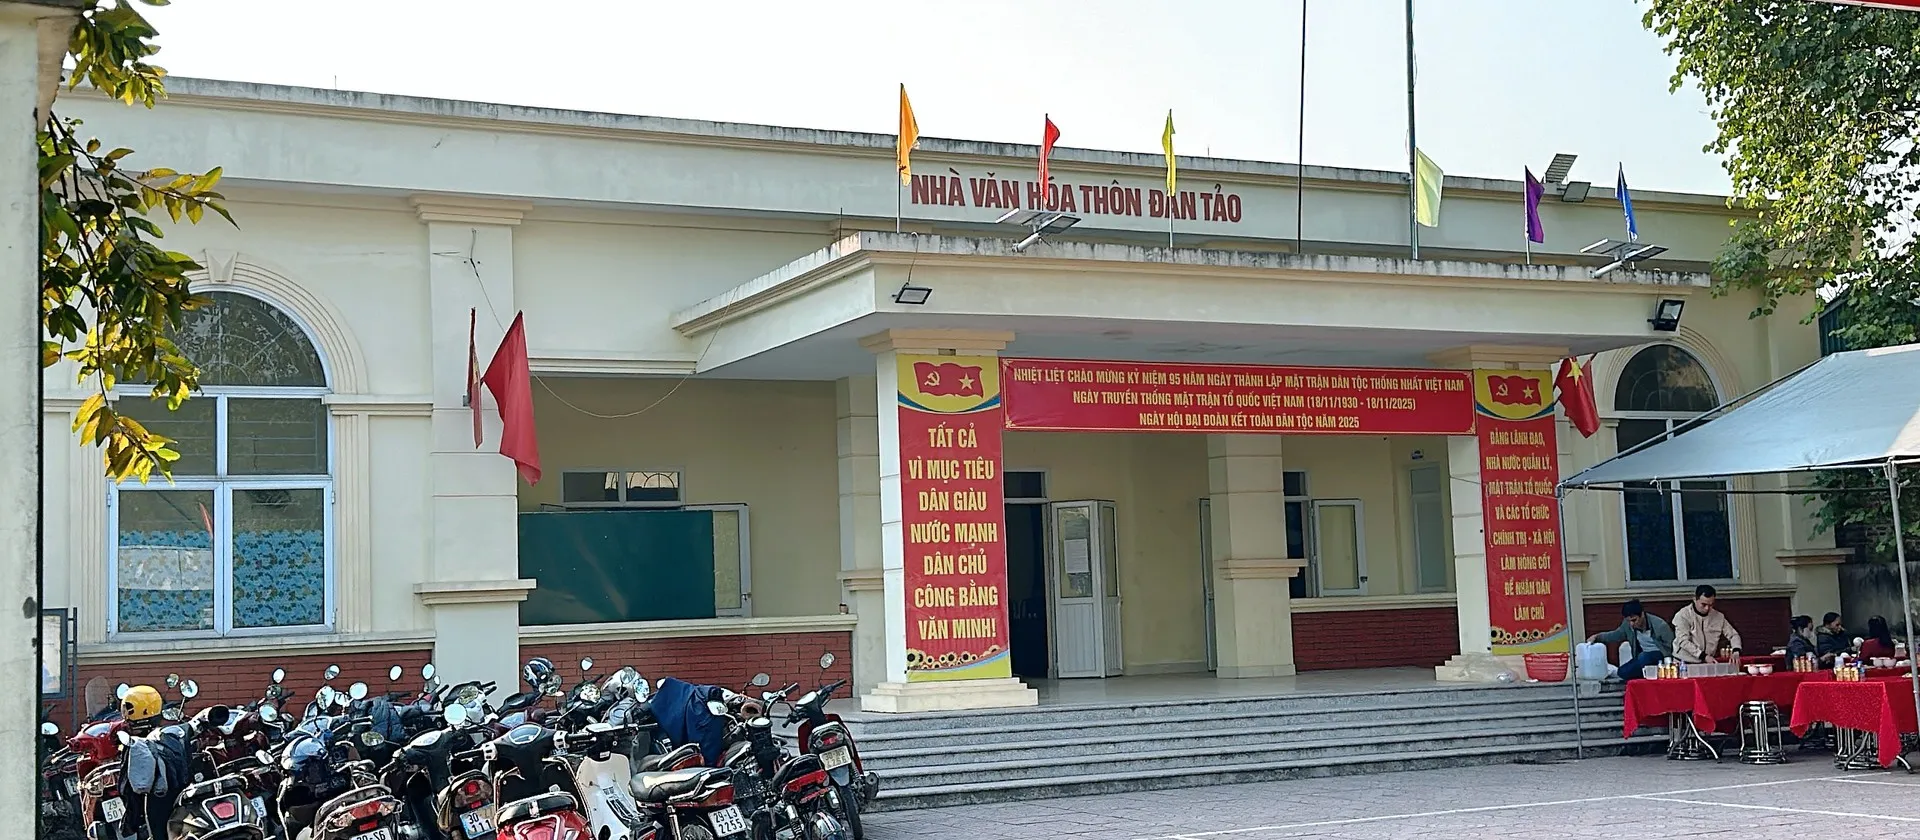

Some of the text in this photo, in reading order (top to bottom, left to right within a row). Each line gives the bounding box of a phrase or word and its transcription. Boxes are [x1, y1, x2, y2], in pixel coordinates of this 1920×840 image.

[911, 167, 965, 206] NHÀ
[969, 172, 1019, 209] VĂN
[1027, 176, 1077, 212] HÓA
[1079, 179, 1142, 217] THÔN
[1200, 183, 1242, 223] TẢO
[1014, 366, 1464, 393] NHIỆT LIỆT CHÀO MỪNG KỶ NIỆM 95 NĂM NGÀY THÀNH LẬP MẶT TRẬN DÂN TỘC THỐNG NHẤT VIỆT NAM
[1073, 389, 1099, 404] NGÀY
[1140, 388, 1171, 405] THỐNG
[1174, 391, 1194, 408] MẶT
[1196, 391, 1220, 408] TRẬN
[1222, 389, 1234, 406] TỔ
[1236, 391, 1260, 408] QUỐC
[1262, 392, 1281, 409] VIỆT
[1283, 395, 1304, 408] NAM
[1307, 396, 1358, 410] (18/11/1930
[1366, 397, 1416, 410] 18/11/2025)
[1139, 410, 1360, 430] NGÀY HỘI ĐẠI ĐOÀN KẾT TOÀN DÂN TỘC NĂM 2025
[928, 421, 977, 448] TẤT CẢ
[1490, 427, 1510, 445] ĐẢNG
[1510, 429, 1529, 445] LÃNH
[908, 456, 995, 484] VÌ MỤC TIÊU
[1486, 454, 1501, 470] NHÀ
[1501, 454, 1521, 470] NƯỚC
[1522, 452, 1541, 471] QUẢN
[1534, 476, 1553, 495] QUỐC
[919, 487, 987, 511] DÂN GIÀU
[1495, 500, 1550, 520] VÀ CÁC TỔ CHỨC
[910, 519, 998, 547] NƯỚC MẠNH
[1493, 529, 1515, 545] CHÍNH
[1515, 531, 1527, 547] TRỊ
[1532, 528, 1543, 545] XÃ
[1543, 528, 1555, 547] HỘI
[924, 548, 987, 576] DÂN CHỦ
[1501, 551, 1551, 570] LÀM NÒNG CỐT
[914, 579, 998, 608] CÔNG BẰNG
[1504, 576, 1551, 595] ĐỂ NHÂN DÂN
[1514, 602, 1545, 620] LÀM CHỦ
[918, 615, 997, 640] VĂN MINH!
[713, 807, 738, 823] 29-L3
[718, 818, 743, 834] 2255
